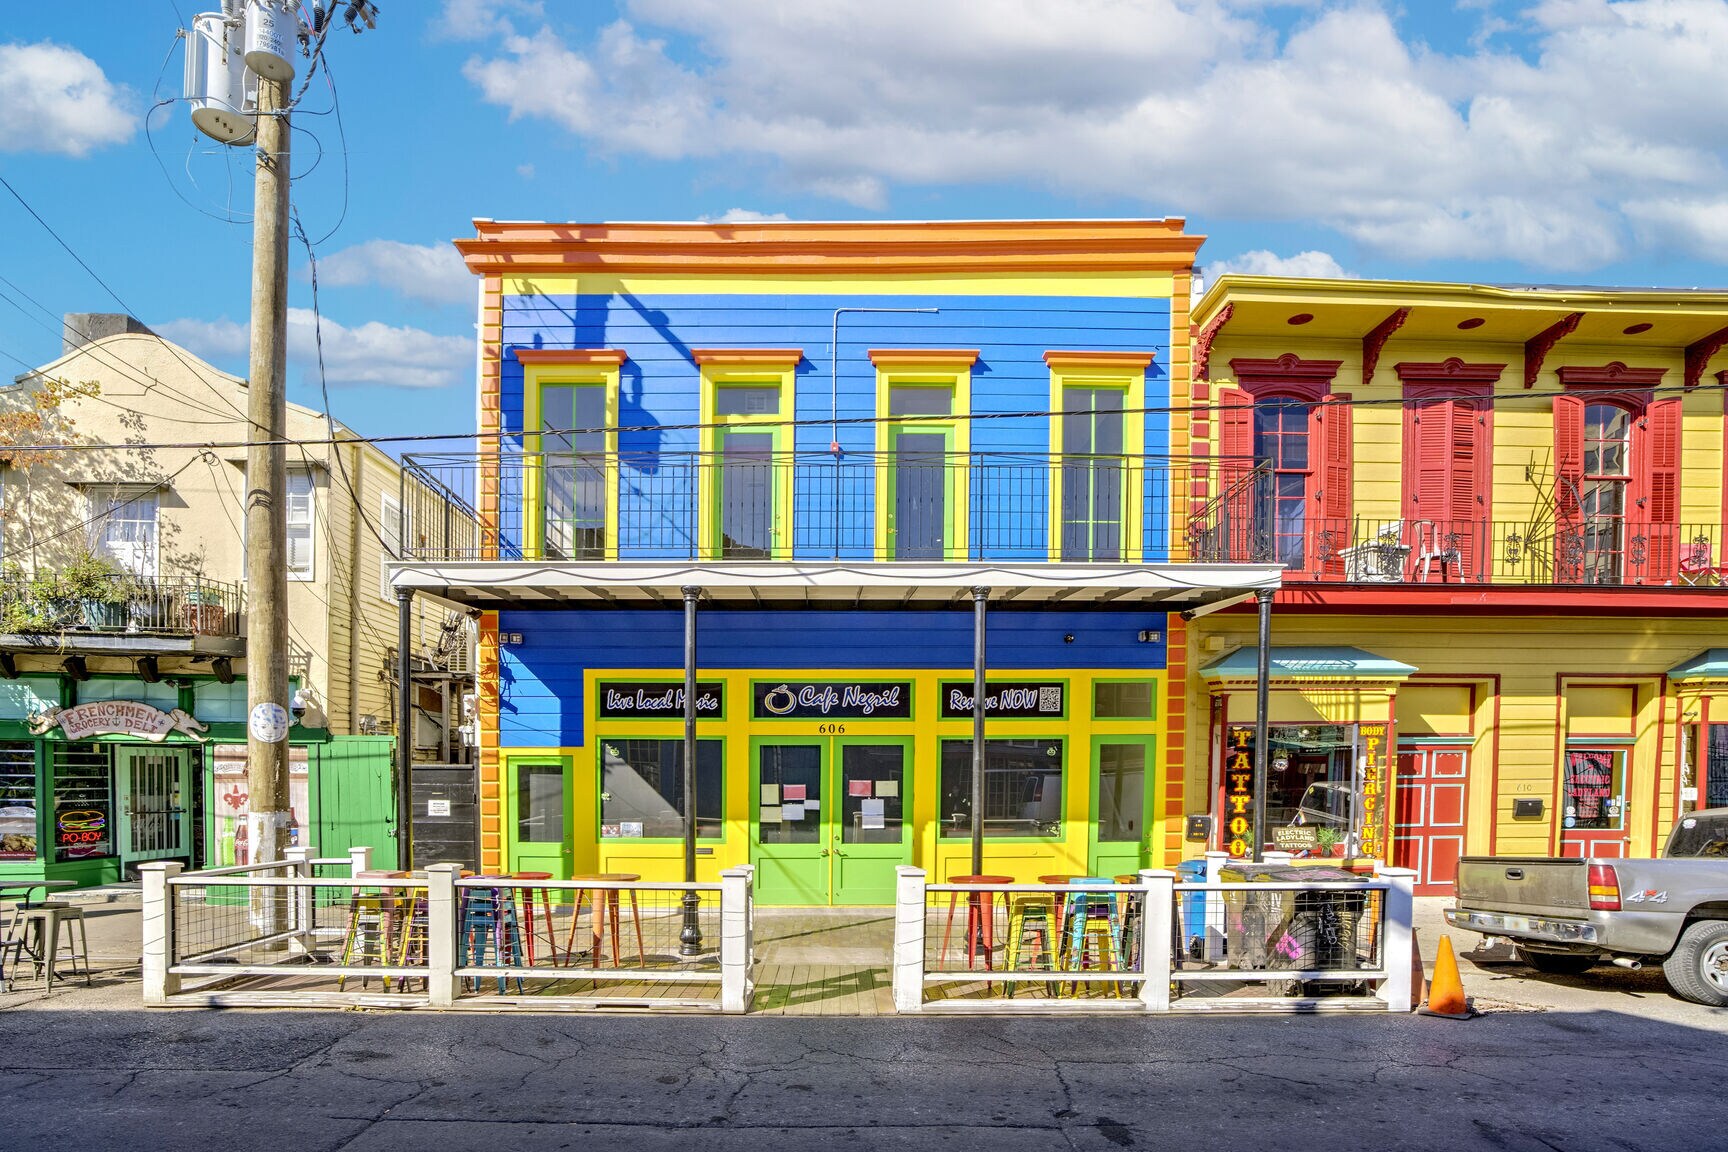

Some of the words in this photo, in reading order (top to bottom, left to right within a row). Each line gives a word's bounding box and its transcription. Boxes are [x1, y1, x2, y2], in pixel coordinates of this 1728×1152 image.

[263, 18, 275, 28] 25
[606, 688, 634, 710] Live
[636, 688, 674, 710] Local
[675, 688, 718, 710] Msic
[798, 685, 839, 714] Cafe
[841, 685, 900, 714] Negril
[950, 688, 998, 710] Resve
[999, 688, 1038, 710] NOW
[64, 704, 158, 725] FRENCHMEN
[69, 717, 111, 734] GROCERY
[124, 718, 158, 733] DELI
[819, 724, 845, 734] 606
[1360, 726, 1385, 736] BODY
[1569, 774, 1611, 784] ELECTRIC
[1229, 730, 1252, 857] TATTOO
[1360, 737, 1380, 855] PIERCING
[1567, 787, 1611, 797] LADYLAND
[62, 831, 102, 843] PO-BOY
[1276, 834, 1315, 842] LADYLAND
